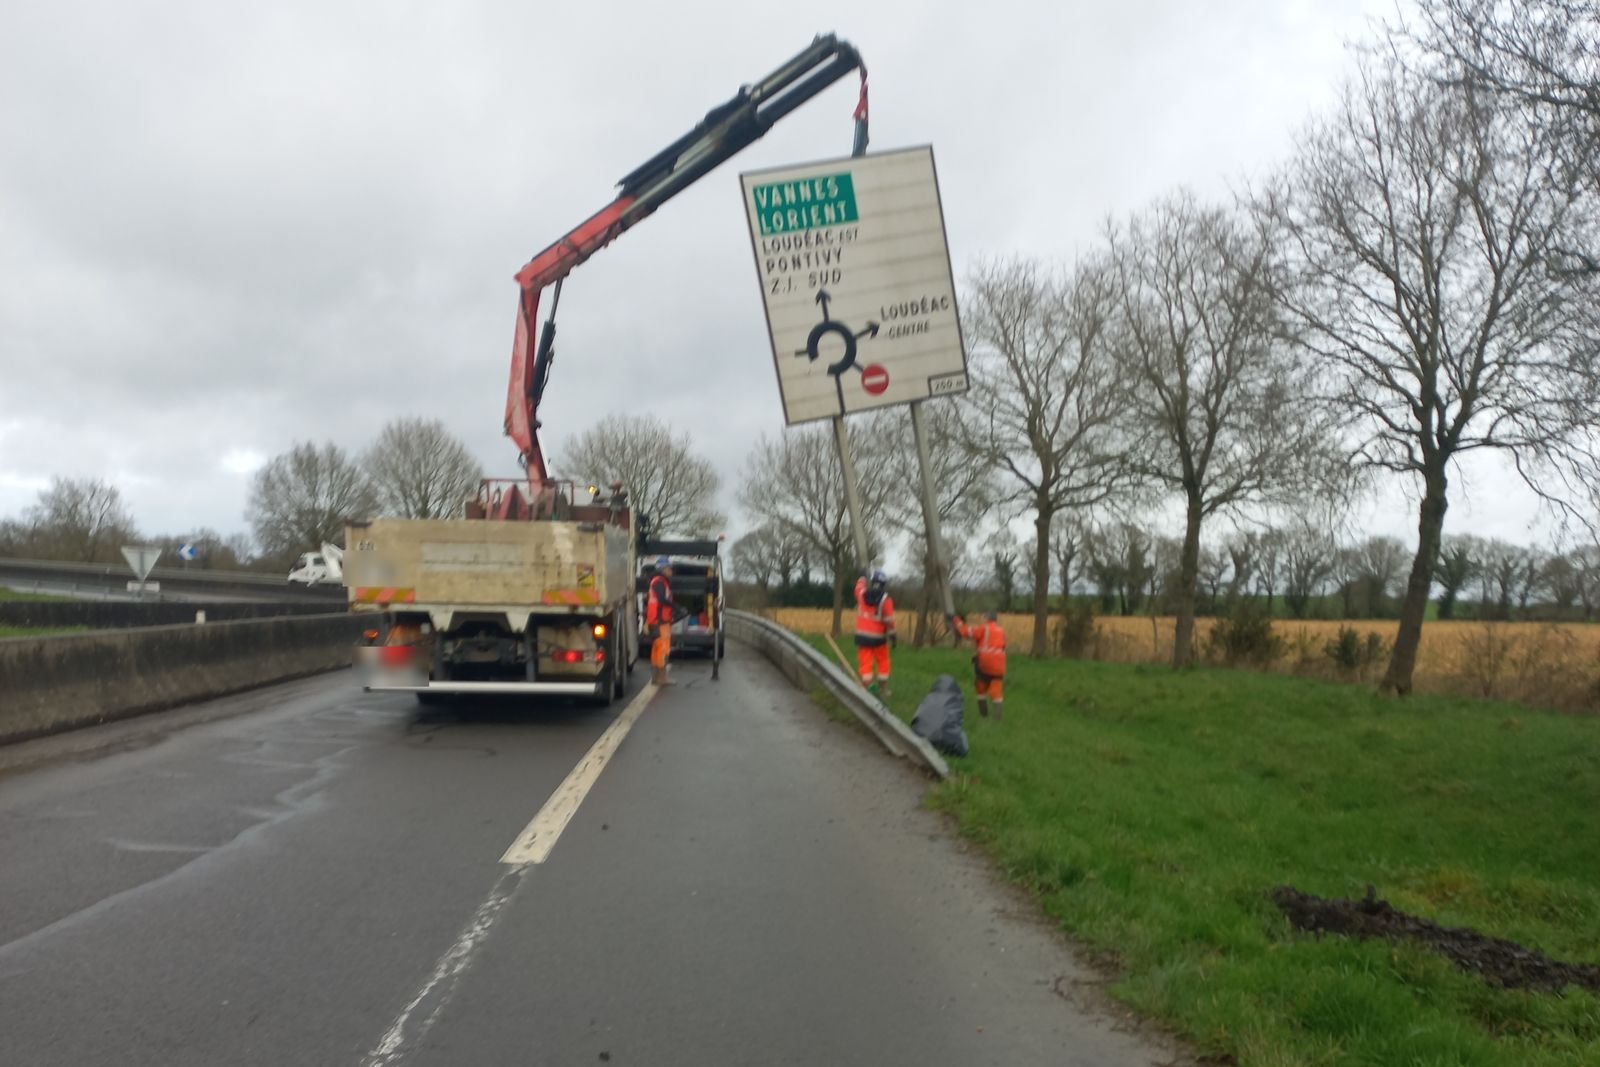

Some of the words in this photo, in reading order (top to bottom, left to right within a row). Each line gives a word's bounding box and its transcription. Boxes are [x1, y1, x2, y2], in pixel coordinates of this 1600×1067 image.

[756, 176, 839, 209] VANNES
[761, 200, 847, 233] LORIENT
[762, 228, 834, 255] LOUDÉAC
[839, 228, 858, 243] EST
[766, 247, 842, 275] PONTIVY
[808, 268, 842, 289] SUD
[881, 294, 949, 321] LOUDÉAC
[888, 321, 929, 339] CENTRE
